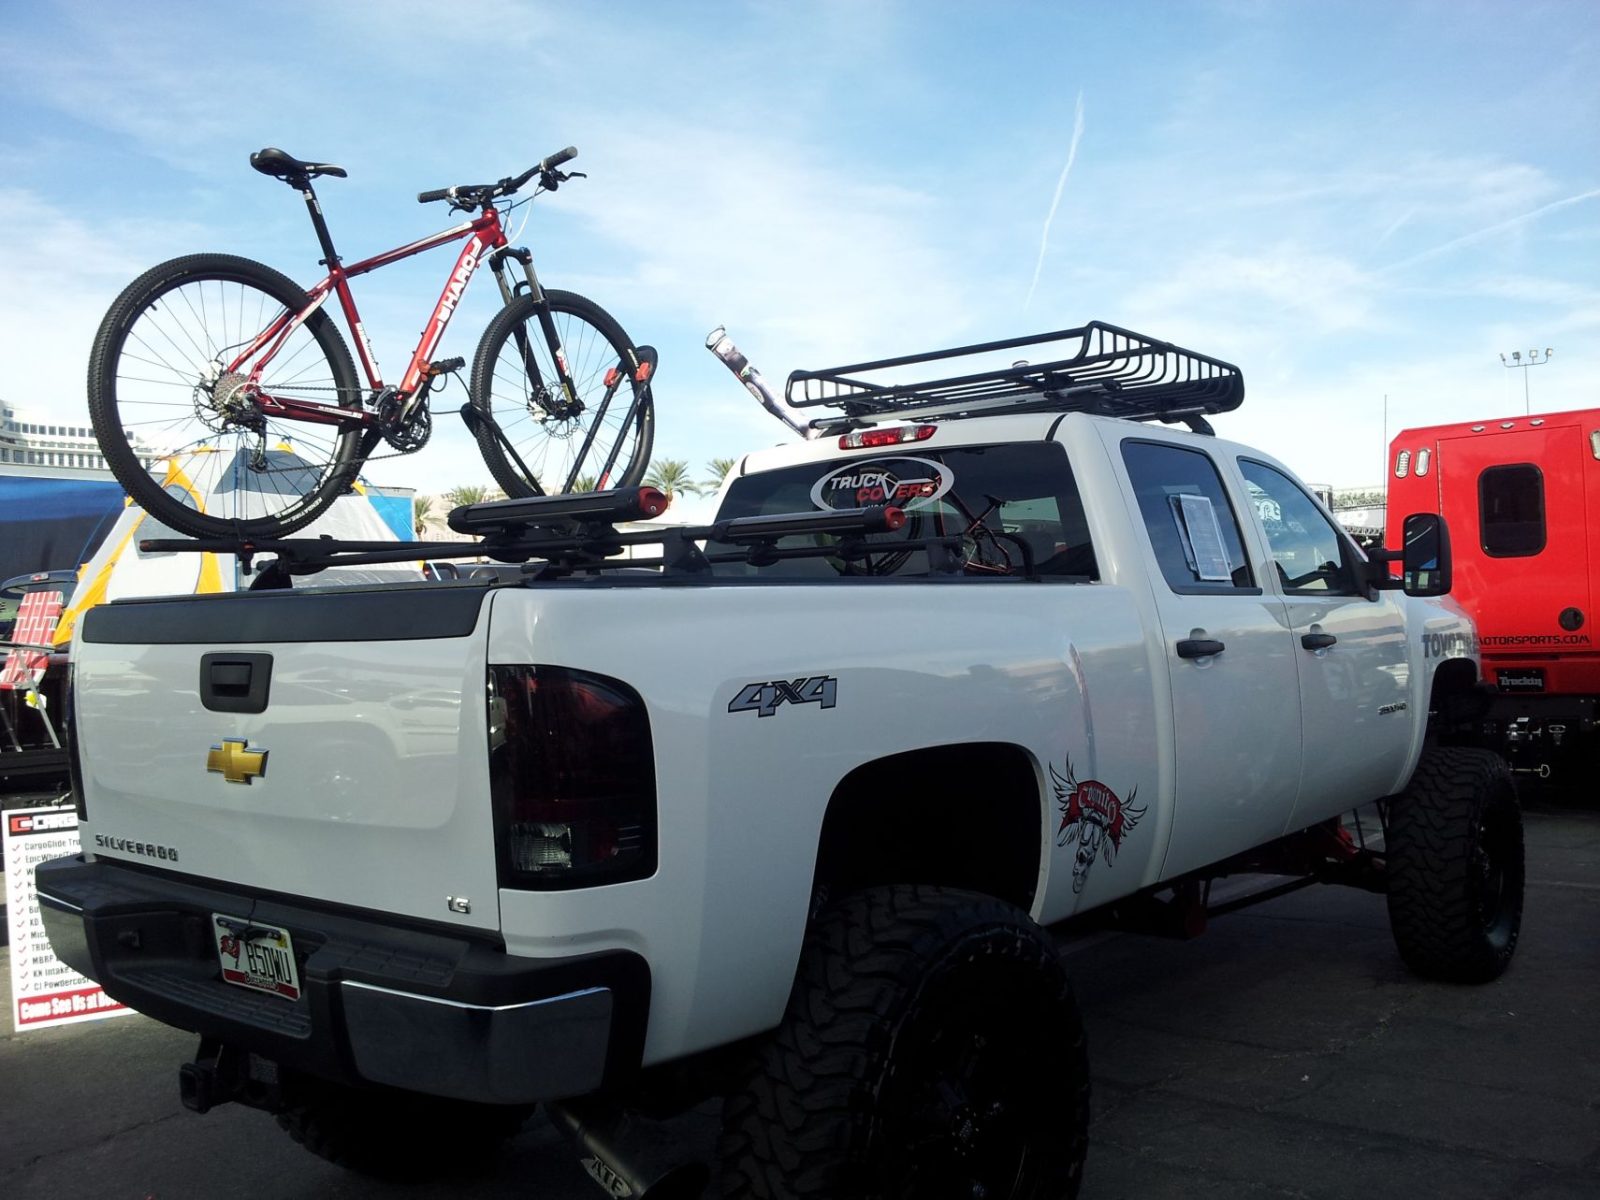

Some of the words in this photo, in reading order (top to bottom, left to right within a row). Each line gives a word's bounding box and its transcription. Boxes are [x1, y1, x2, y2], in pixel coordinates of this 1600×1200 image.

[442, 253, 476, 310] HARO
[830, 472, 890, 490] TRUCK
[856, 482, 935, 501] COVERS
[95, 834, 179, 862] SILVERADO
[51, 997, 72, 1015] See
